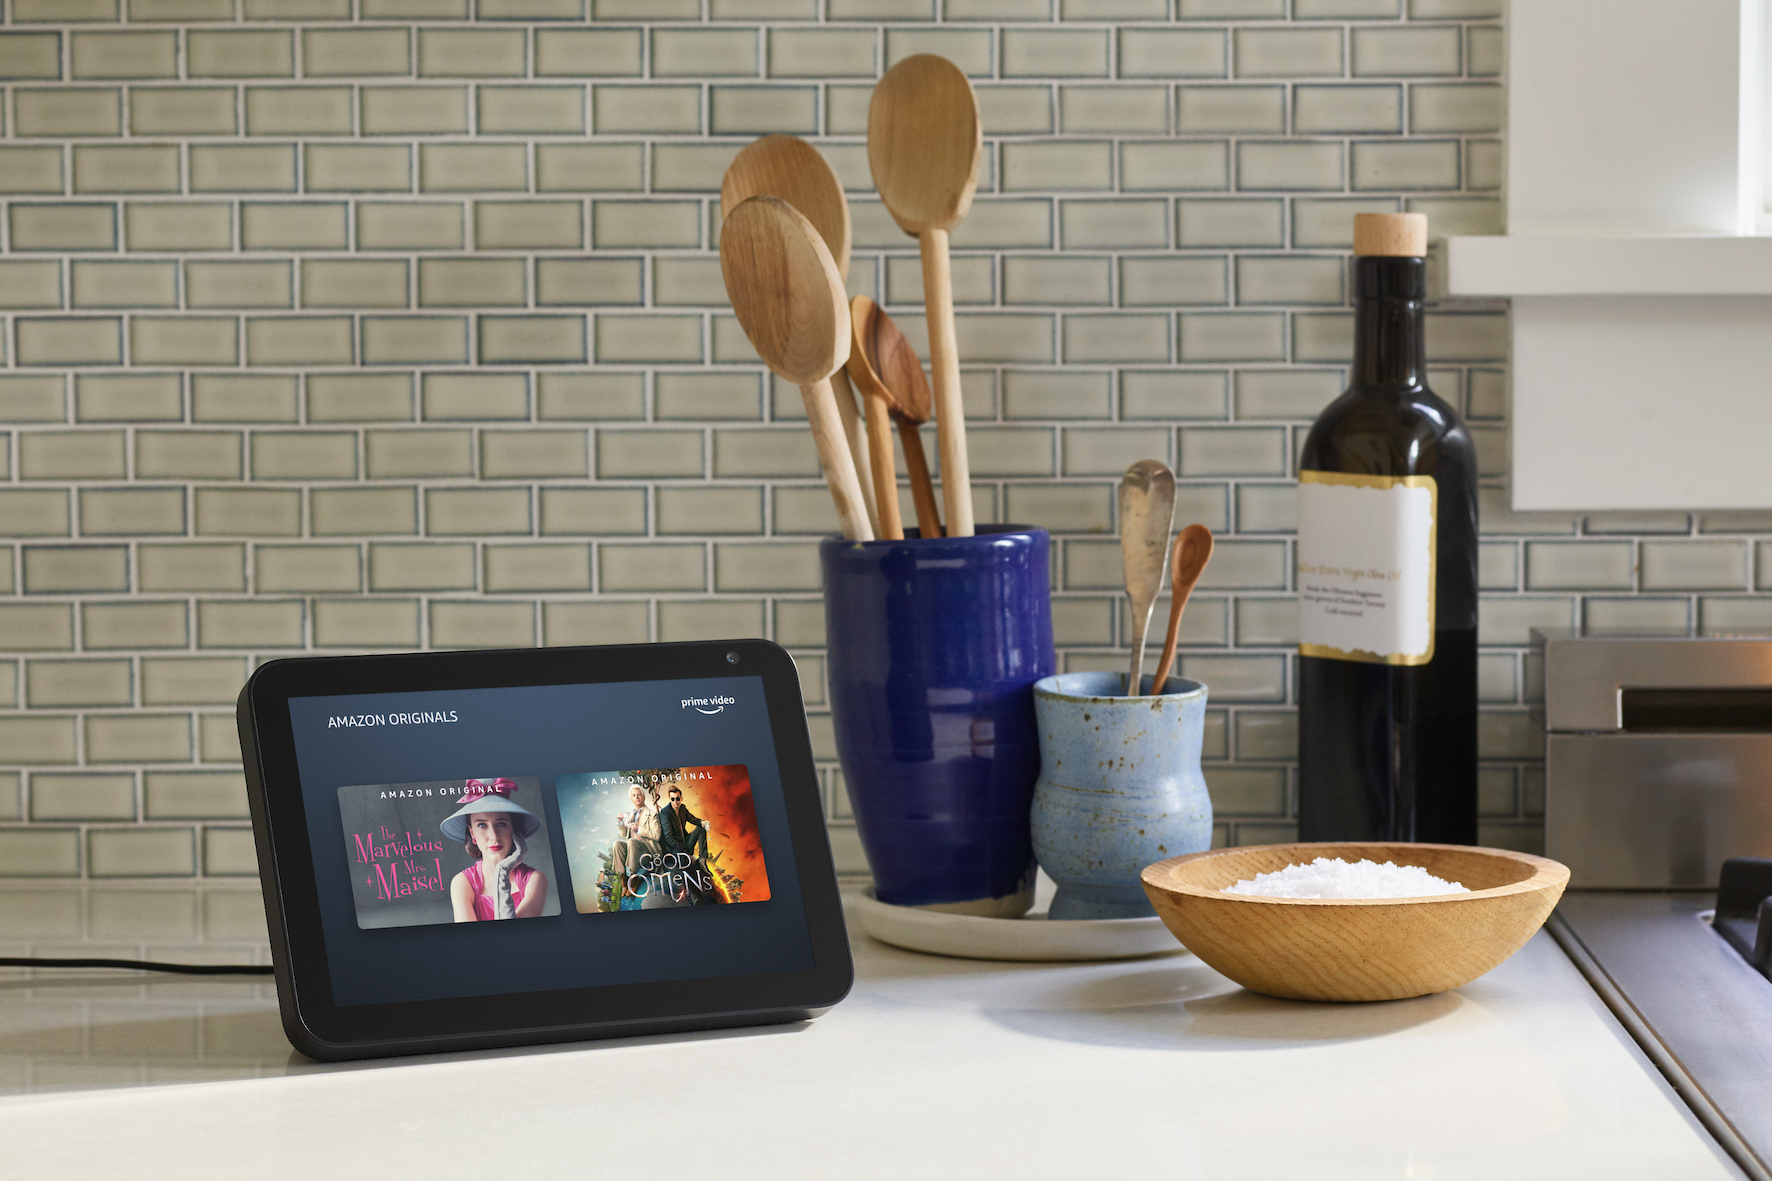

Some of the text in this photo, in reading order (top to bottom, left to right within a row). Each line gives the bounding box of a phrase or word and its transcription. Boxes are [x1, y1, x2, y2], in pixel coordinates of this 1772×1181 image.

[681, 695, 735, 709] prime video
[328, 710, 459, 728] AMAZON ORIGINALS
[592, 771, 714, 786] AMAZON ORIGINAL
[380, 784, 502, 799] AMAZON ORIGINAL
[379, 825, 396, 841] The
[352, 832, 444, 865] Marvelous
[372, 858, 445, 902] Maisel
